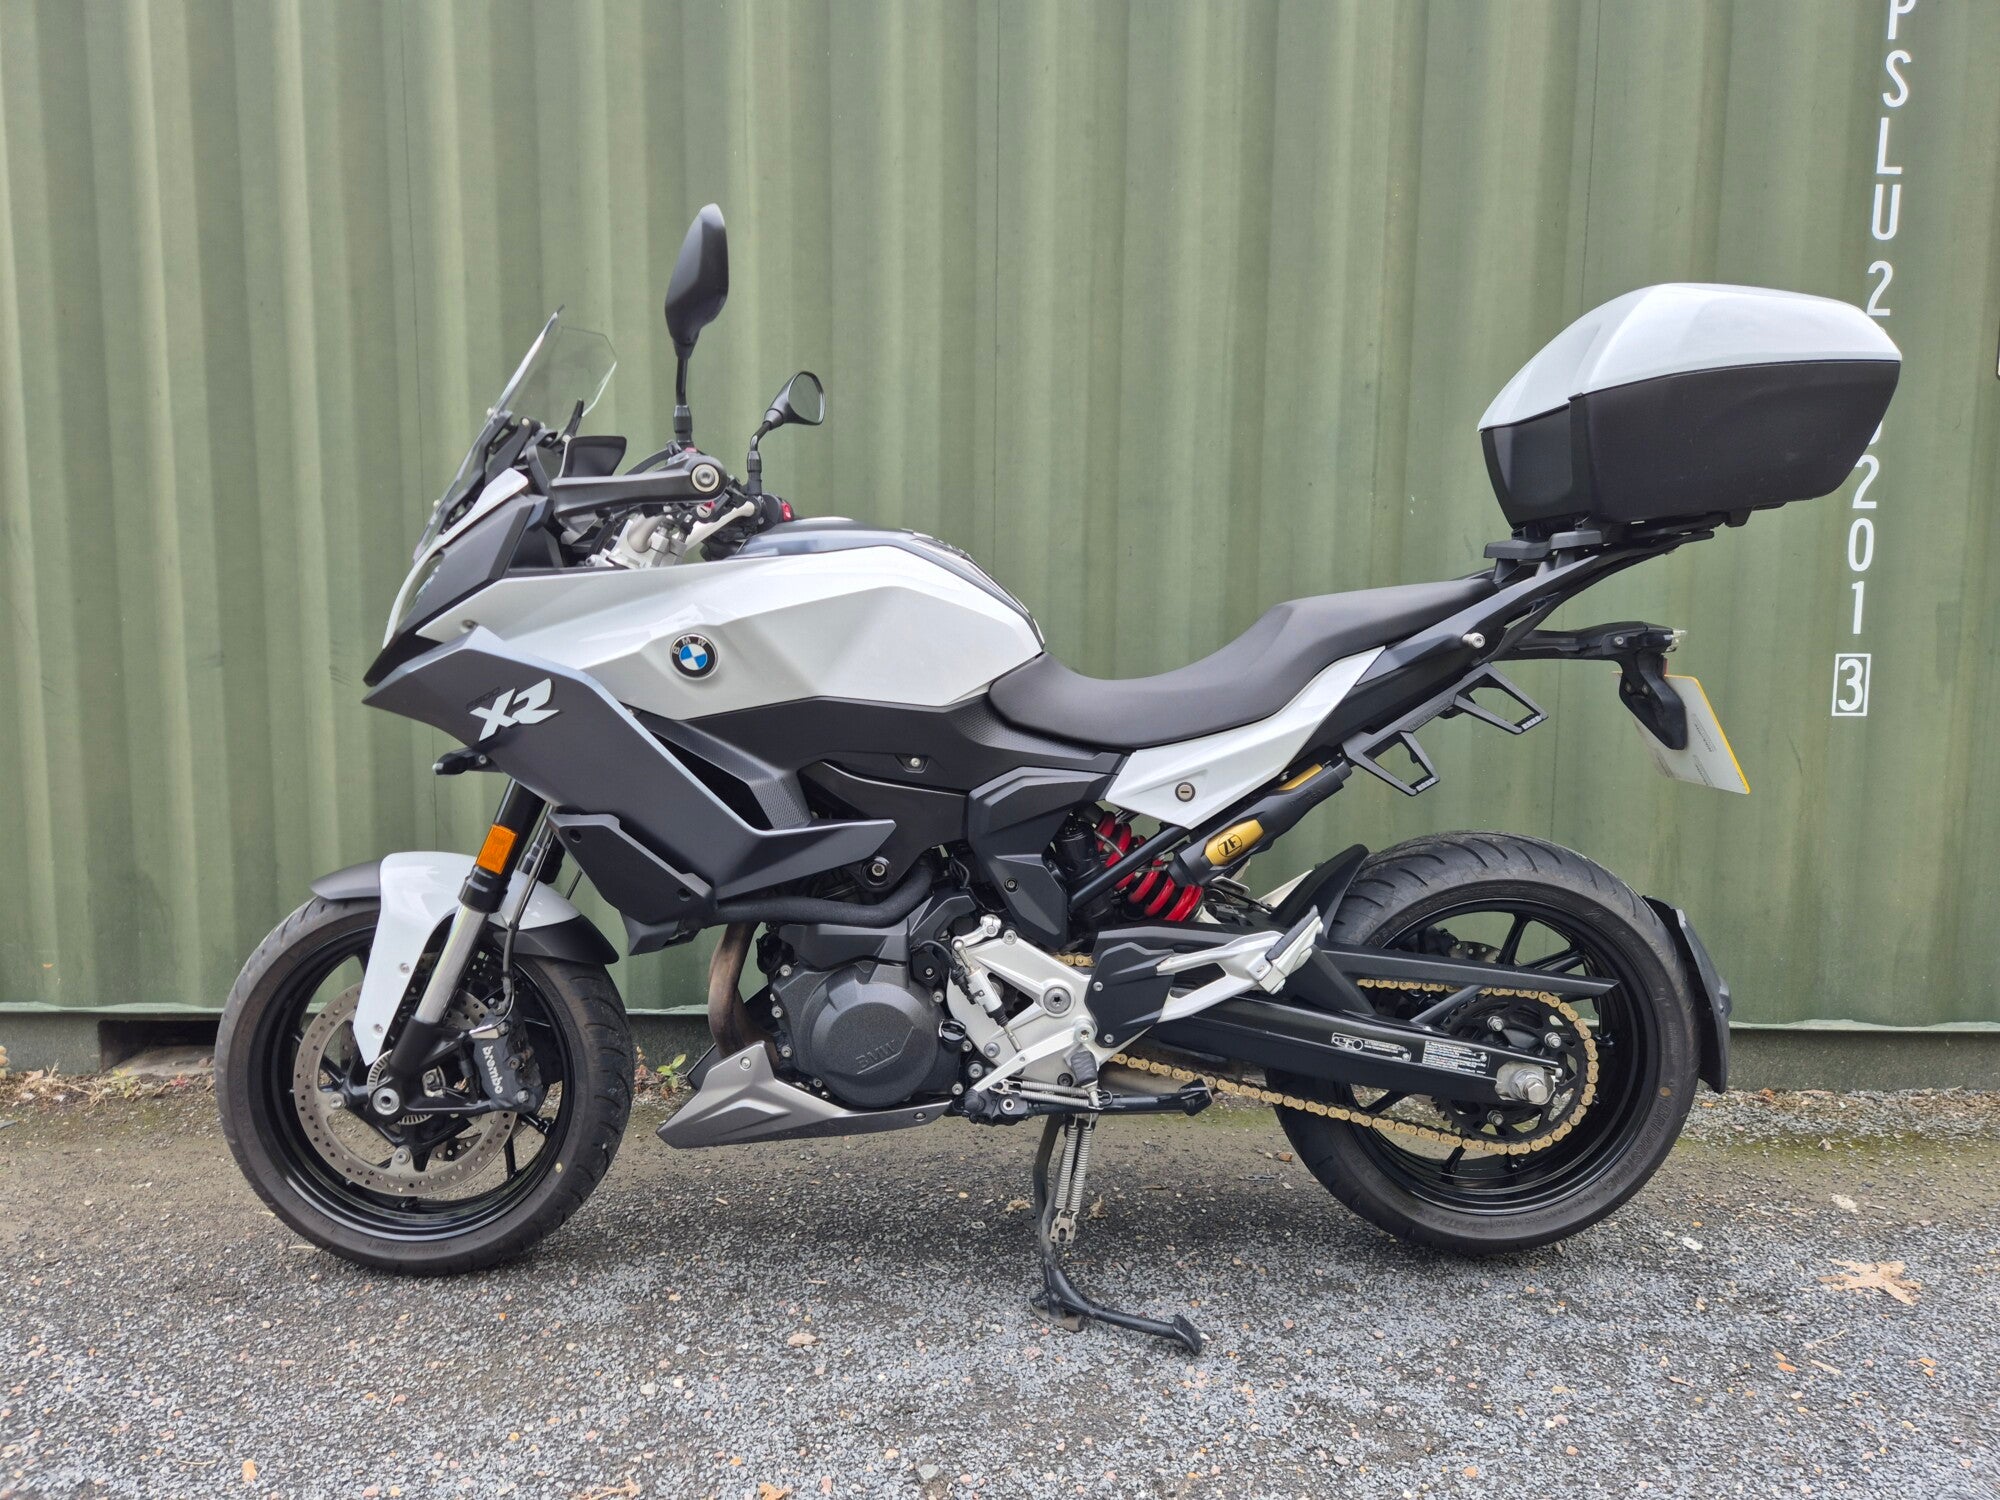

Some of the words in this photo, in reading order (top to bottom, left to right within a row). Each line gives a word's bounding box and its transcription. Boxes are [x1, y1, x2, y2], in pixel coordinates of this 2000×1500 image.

[1872, 0, 1916, 241] PSLU
[672, 636, 707, 655] BMW
[1218, 835, 1242, 857] ZF
[482, 1045, 504, 1095] brembo
